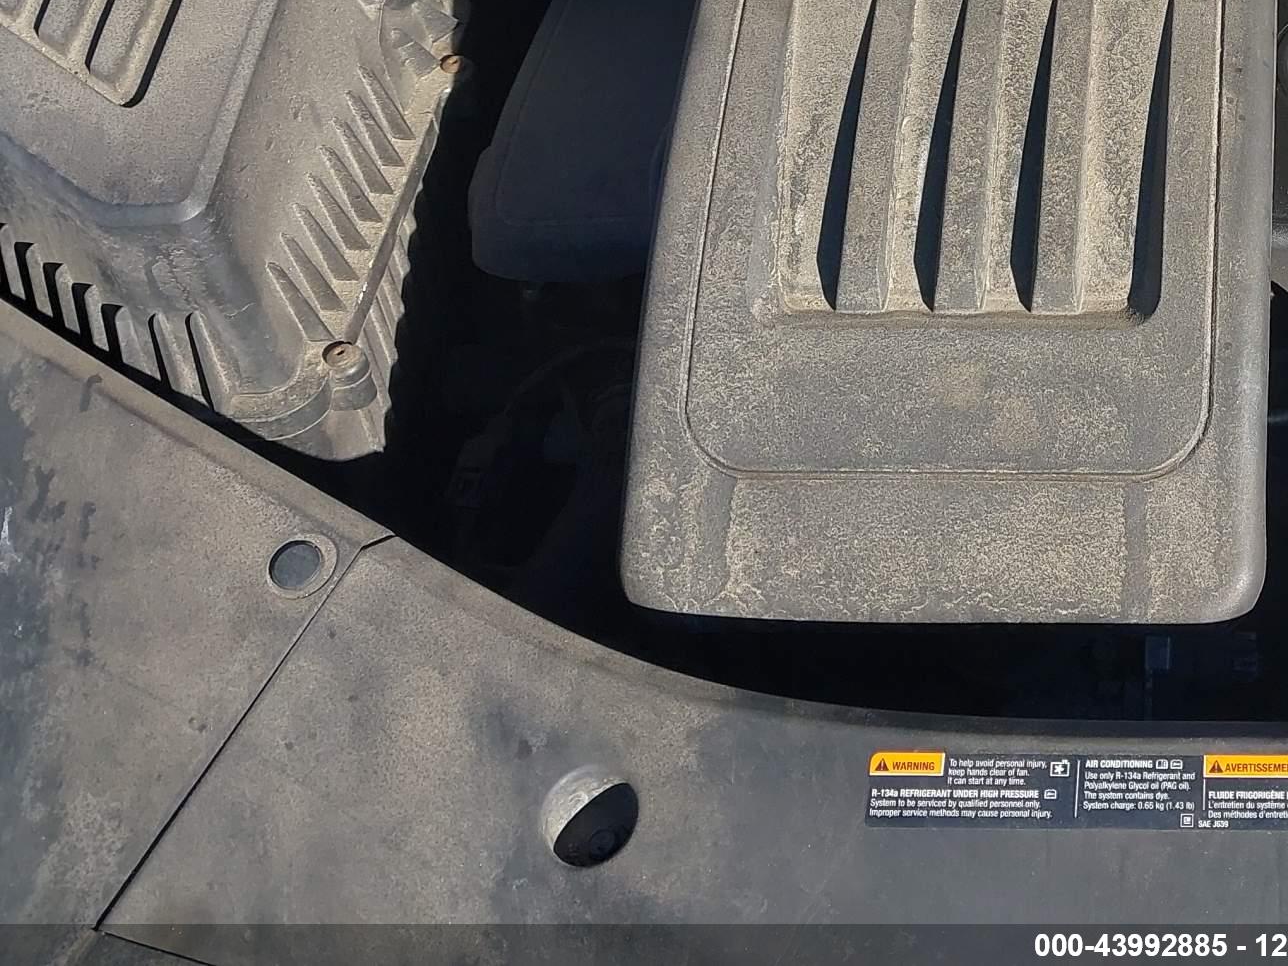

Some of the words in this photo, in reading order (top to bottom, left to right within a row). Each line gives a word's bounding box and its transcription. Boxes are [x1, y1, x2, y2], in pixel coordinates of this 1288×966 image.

[893, 762, 935, 770] WARNING
[950, 759, 957, 767] To
[976, 759, 994, 767] avoid
[996, 760, 1025, 768] personal
[1027, 760, 1047, 769] injury,
[1086, 760, 1098, 768] AIR
[1100, 760, 1153, 769] CONDITIONING
[948, 768, 965, 776] keep
[1085, 772, 1098, 780] Use
[1100, 772, 1114, 781] only
[1116, 772, 1141, 780] R-134a
[1143, 772, 1181, 781] Refrigerant
[1182, 772, 1196, 780] and
[1084, 782, 1126, 791] Polyalkylene
[1129, 782, 1149, 791] Glycol
[1151, 782, 1159, 790] oil
[1161, 782, 1177, 791] (PAG
[872, 789, 899, 797] R-134a
[900, 789, 952, 797] REFRIGERANT
[953, 790, 979, 798] UNDER
[981, 790, 999, 798] HIGH
[1001, 790, 1039, 798] PRESSURE
[1084, 791, 1097, 799] The
[1098, 791, 1123, 800] system
[1125, 792, 1153, 800] contains
[1156, 792, 1170, 801] dye.
[1208, 791, 1234, 799] FLUIDE
[870, 799, 896, 808] System
[948, 800, 957, 808] by
[959, 800, 988, 809] qualified
[990, 800, 1024, 809] personnel
[1026, 801, 1041, 809] only.
[1083, 801, 1109, 811] System
[1110, 801, 1136, 811] charge:
[1156, 802, 1164, 811] kg
[1166, 802, 1184, 811] (1.43
[1186, 802, 1195, 811] lb)
[1246, 801, 1255, 809] du
[870, 808, 901, 818] Improper
[930, 809, 959, 817] methods
[1000, 810, 1030, 818] personal
[1032, 810, 1053, 819] injury.
[1208, 811, 1222, 819] Des
[1198, 820, 1211, 828] SAE
